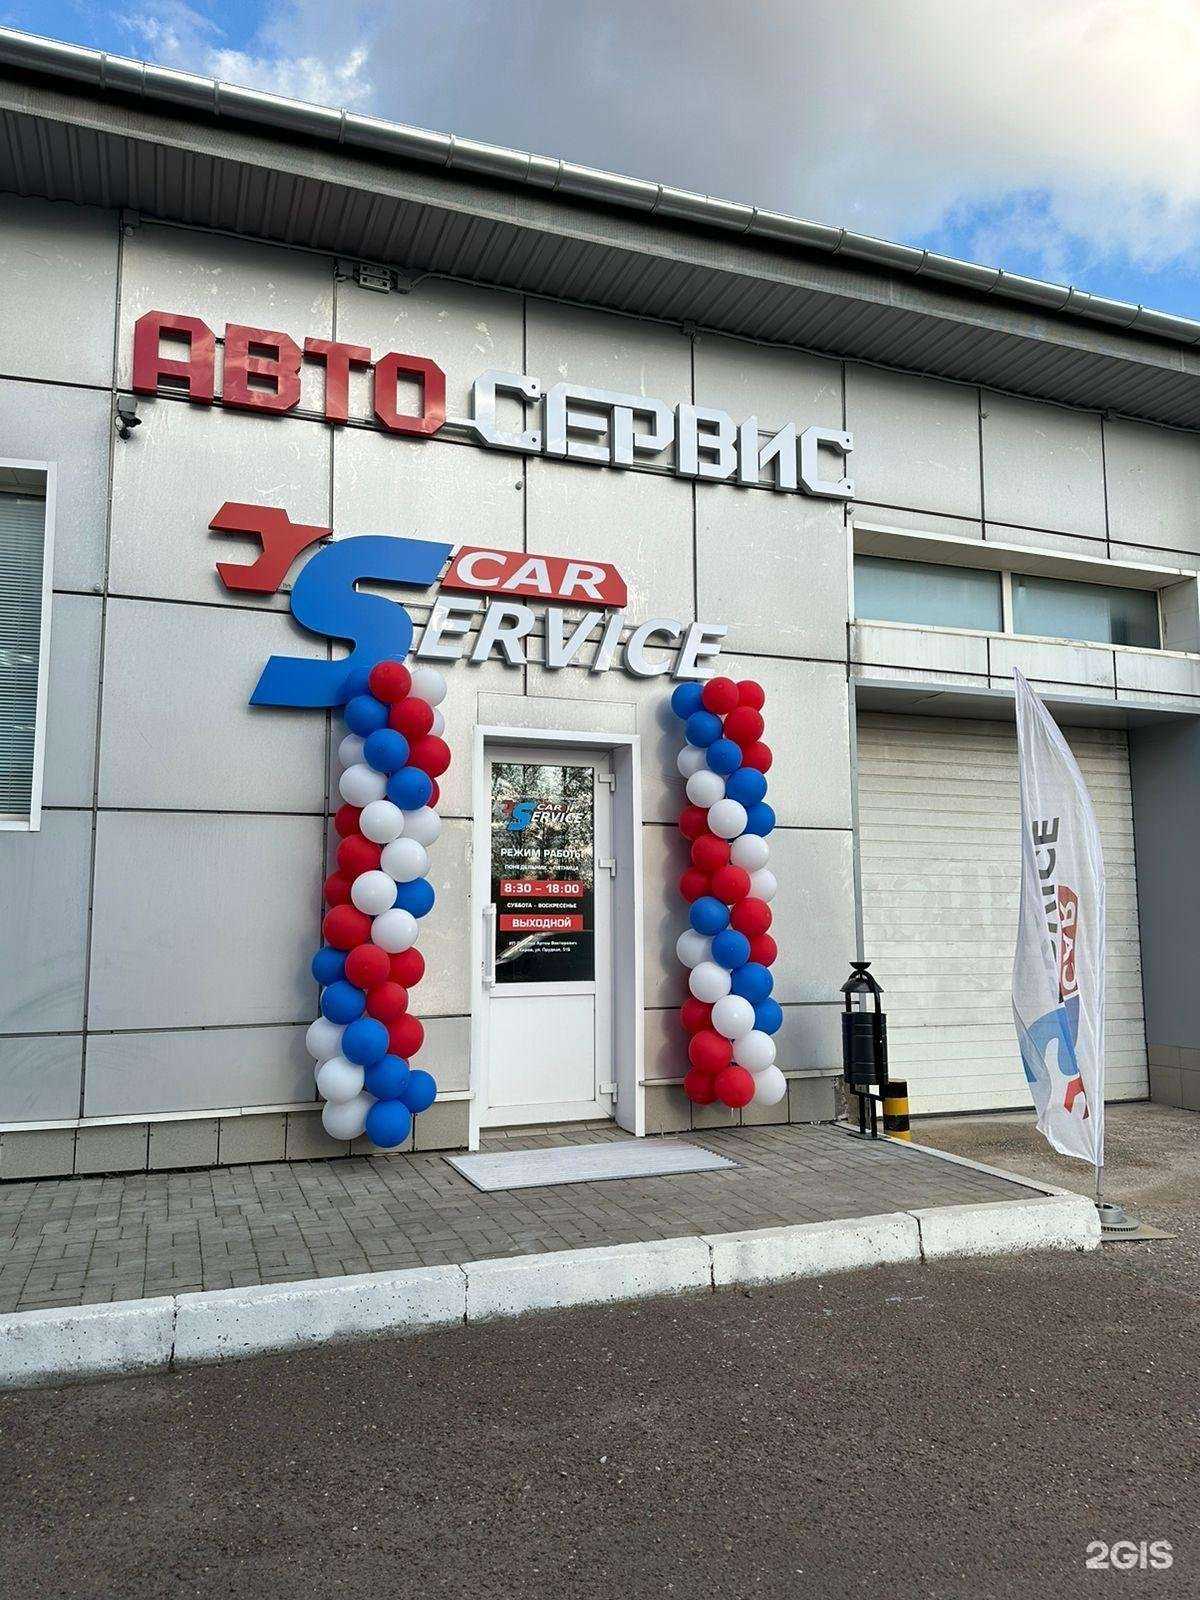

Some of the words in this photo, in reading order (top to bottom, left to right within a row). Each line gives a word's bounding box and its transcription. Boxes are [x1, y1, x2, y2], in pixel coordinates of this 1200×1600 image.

[133, 310, 446, 438] АВТО
[471, 370, 856, 500] СЕРВИС
[455, 551, 607, 601] CAR
[536, 803, 562, 811] CAR
[500, 848, 541, 858] РЕЖИМ
[504, 883, 532, 893] 8:30
[545, 884, 580, 894] 18:00
[512, 917, 572, 929] ВЫХОДНОЙ
